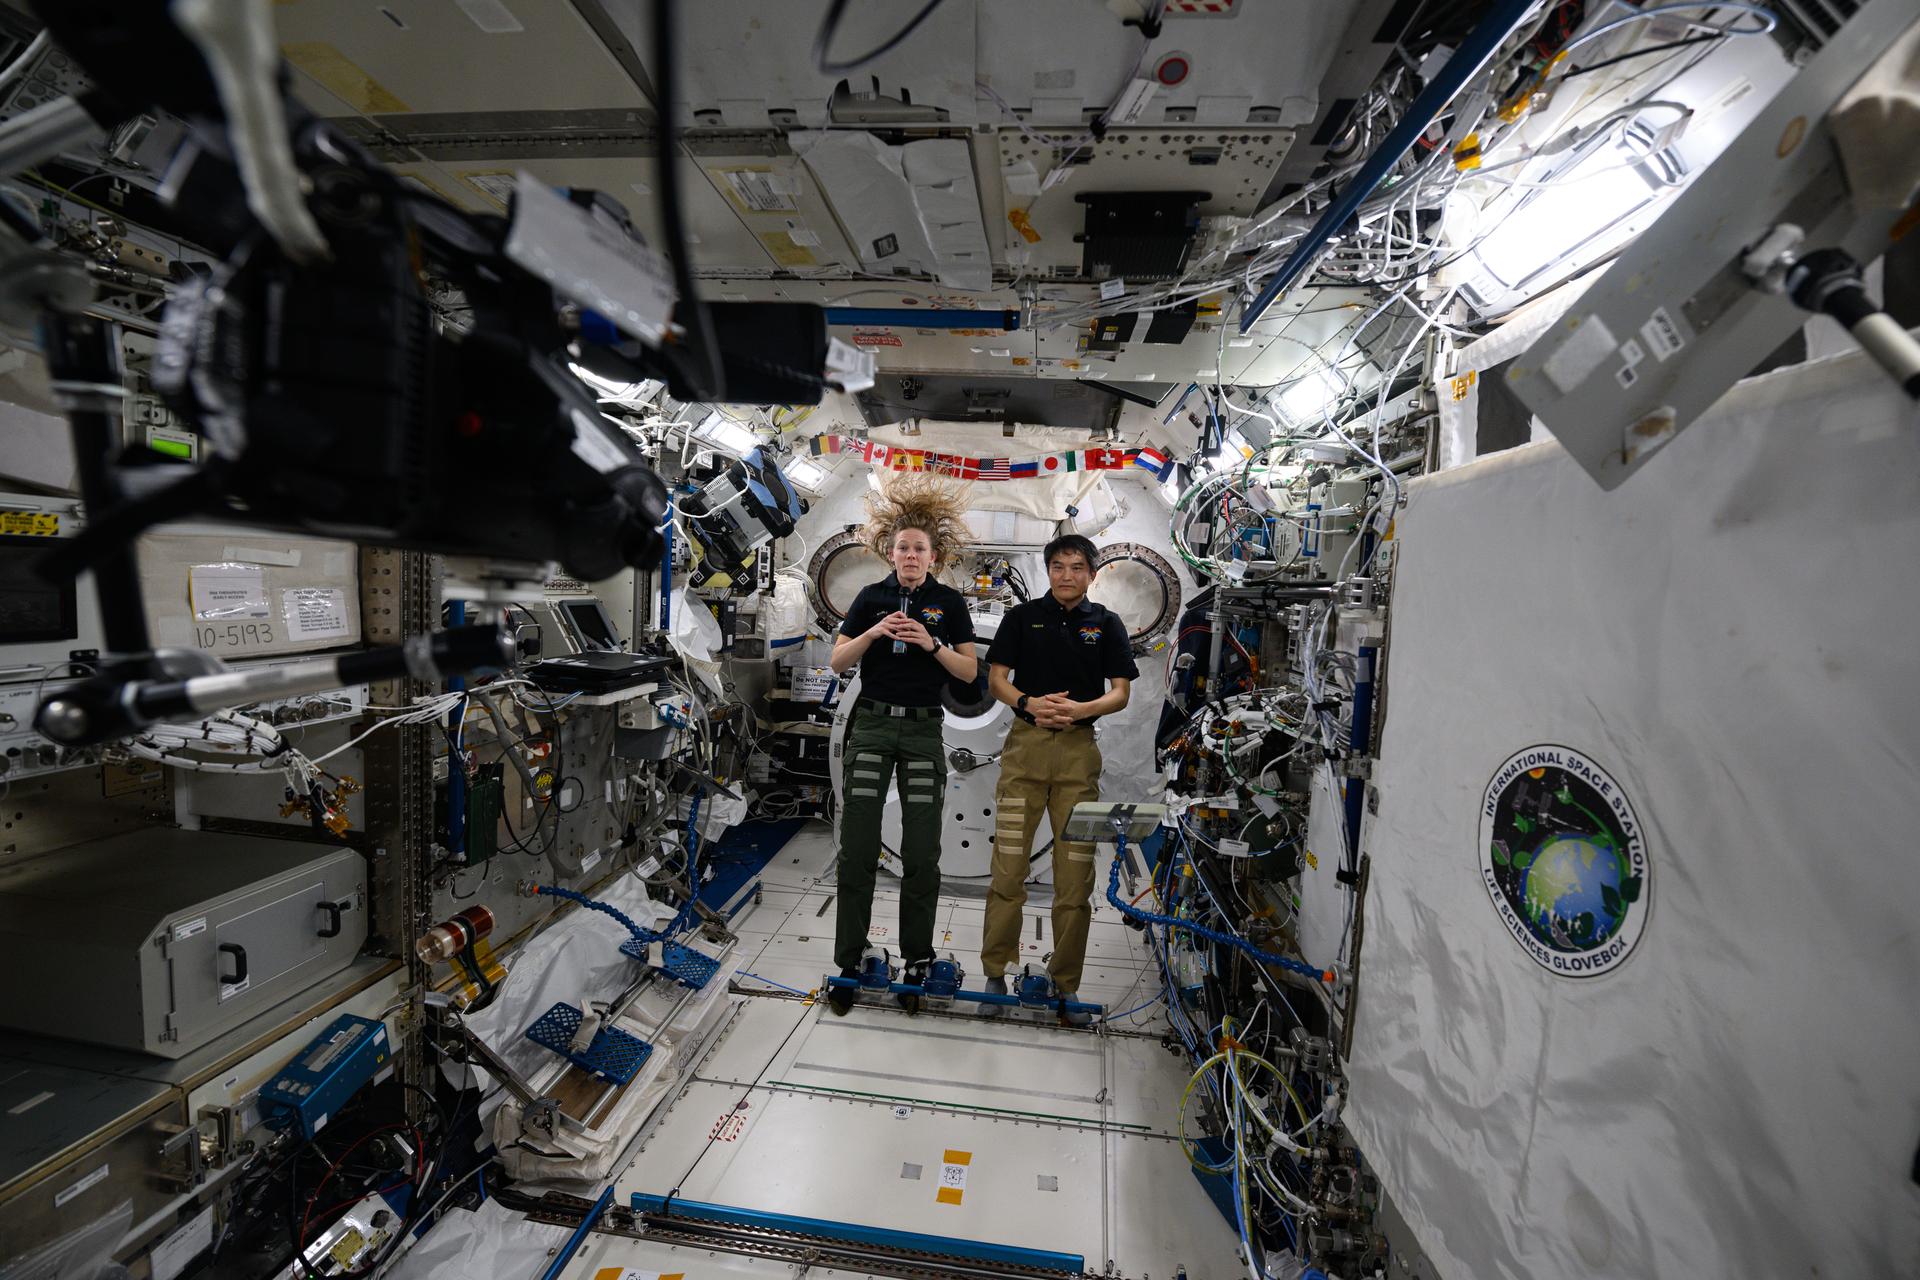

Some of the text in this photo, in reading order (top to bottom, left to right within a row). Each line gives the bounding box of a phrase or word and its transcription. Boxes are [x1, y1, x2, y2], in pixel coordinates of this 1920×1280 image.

[1485, 750, 1644, 878] INTERNATIONAL SPACE STATION
[1484, 867, 1628, 971] LIFE SCIENCES GLOVEBOX
